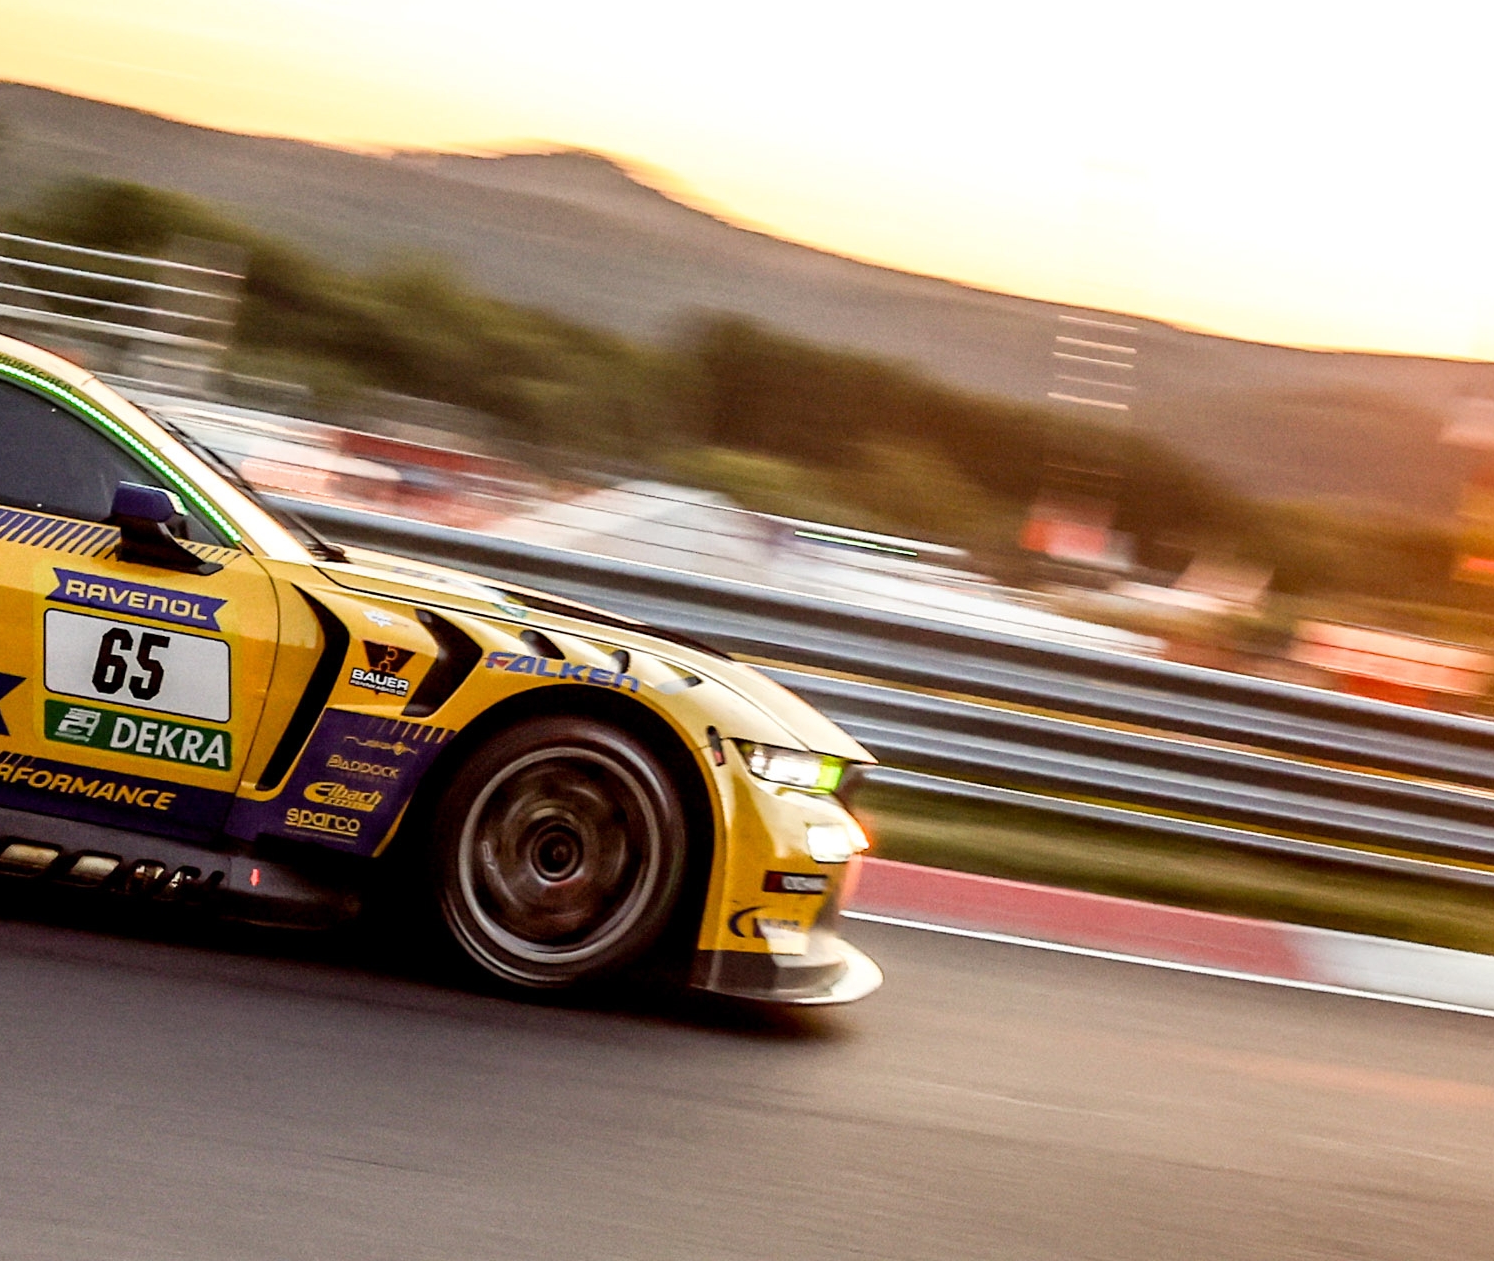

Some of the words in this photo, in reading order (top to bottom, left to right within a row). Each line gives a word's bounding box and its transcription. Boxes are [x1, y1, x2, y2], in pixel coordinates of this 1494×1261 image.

[65, 578, 208, 621] RAVENOL
[91, 626, 171, 701] 65
[352, 668, 410, 691] BAUER
[485, 651, 640, 693] FALKEN
[109, 716, 226, 768] DEKRA
[285, 807, 361, 832] sparco
